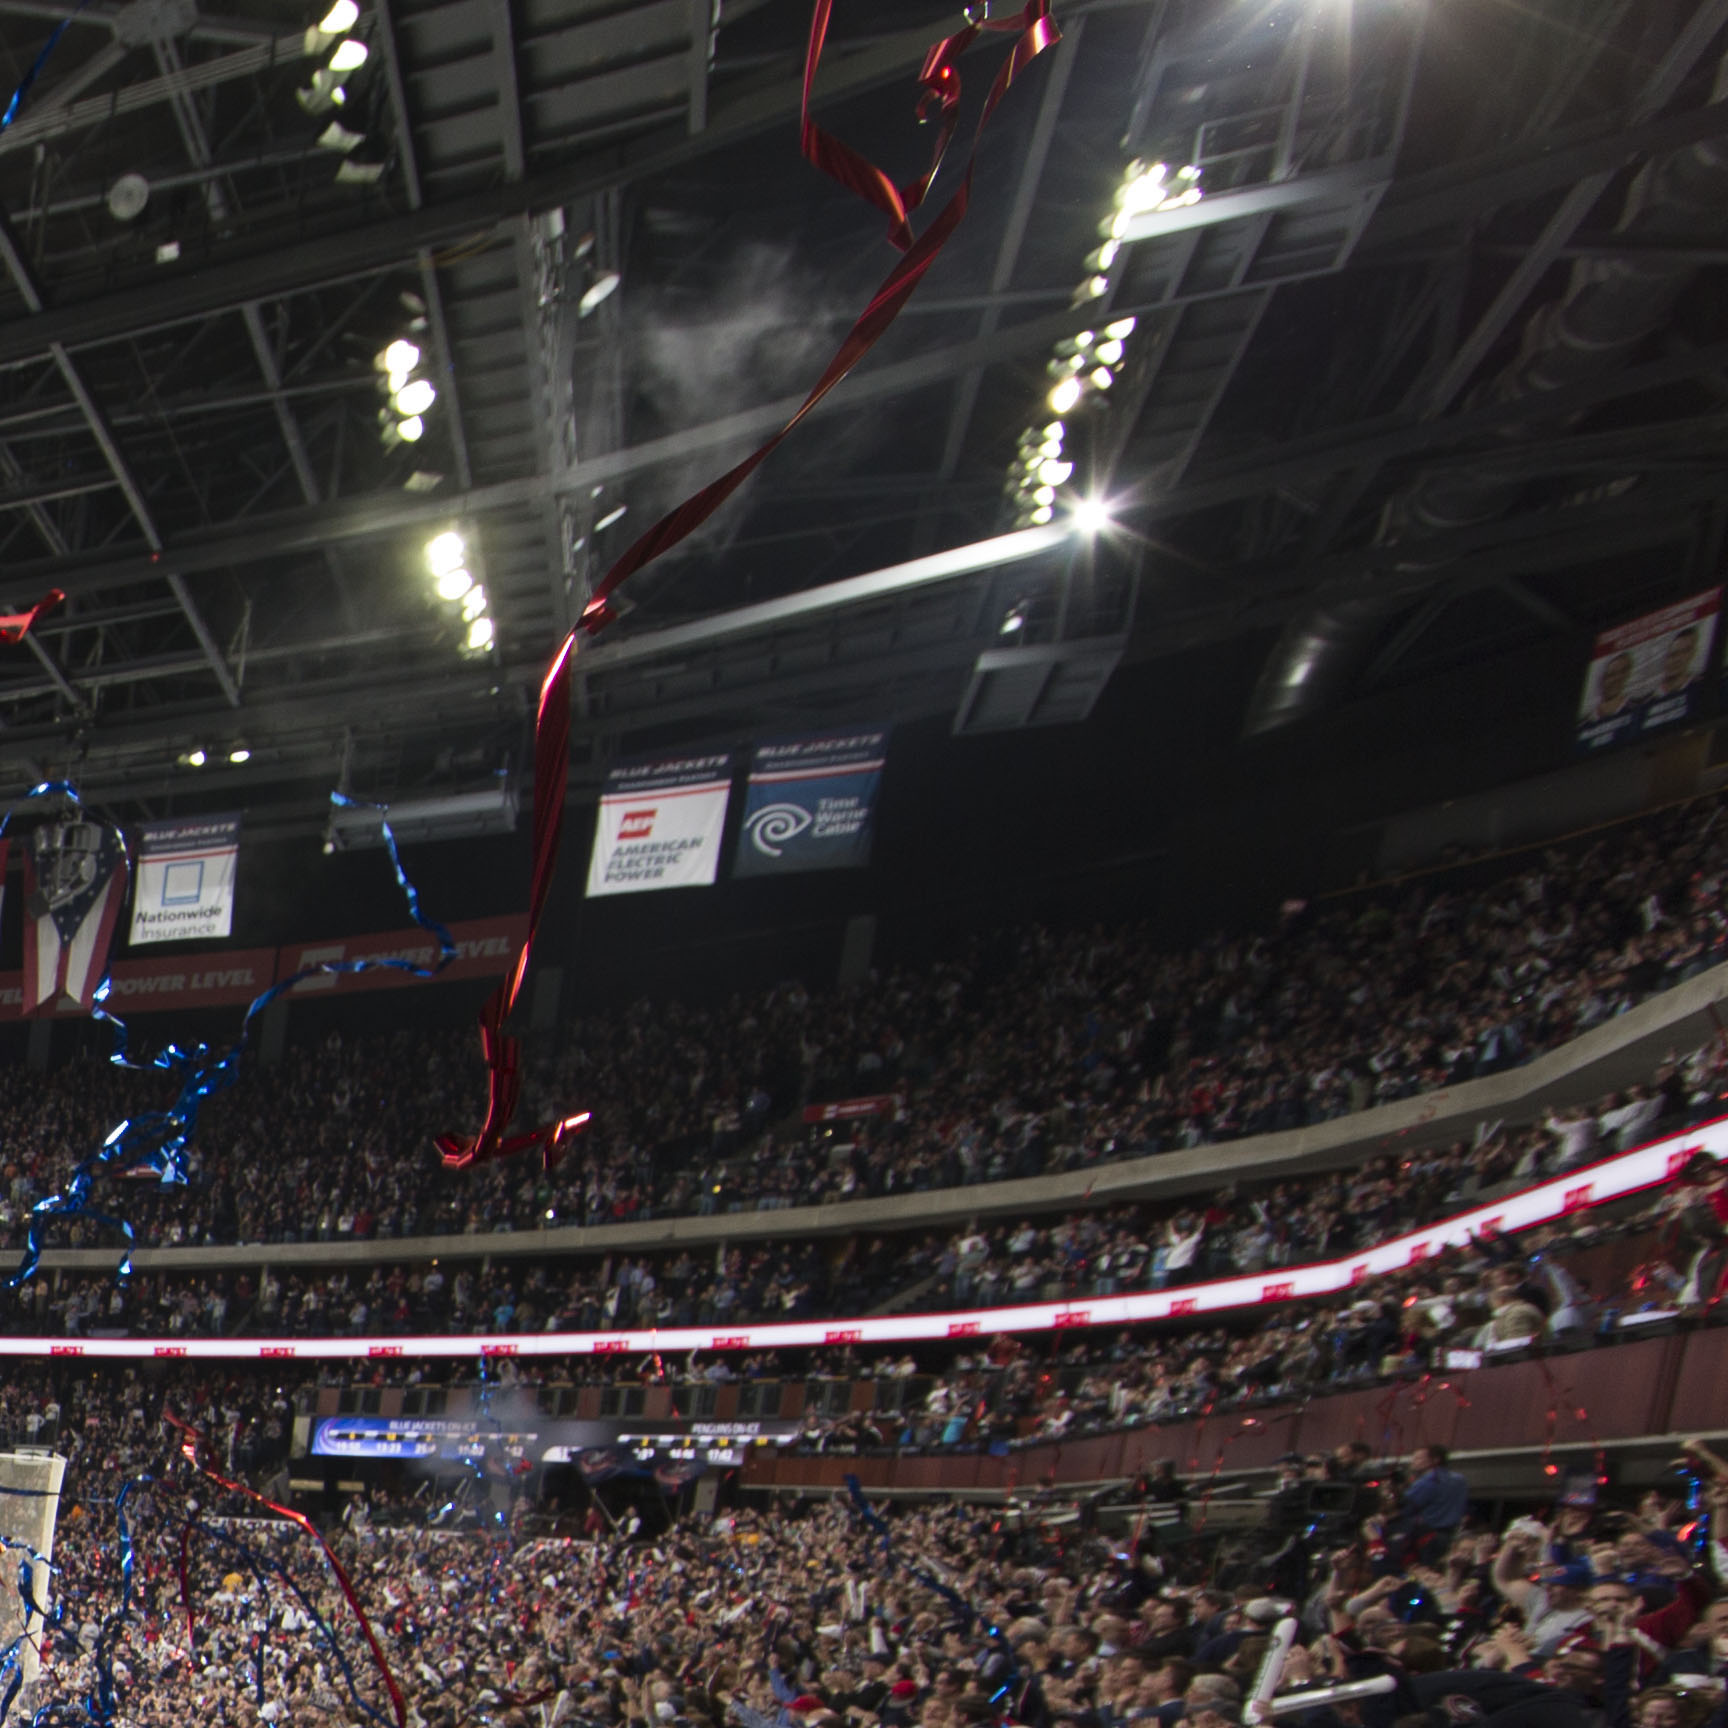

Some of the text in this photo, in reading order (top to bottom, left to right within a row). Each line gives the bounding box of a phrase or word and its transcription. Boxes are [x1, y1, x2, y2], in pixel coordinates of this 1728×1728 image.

[612, 837, 703, 858] AMERICAN
[608, 852, 681, 870] ELECTRIC
[604, 867, 665, 884] POWER
[135, 904, 223, 925] Nationwide
[140, 921, 217, 939] Insurance
[191, 969, 256, 991] LEVEL
